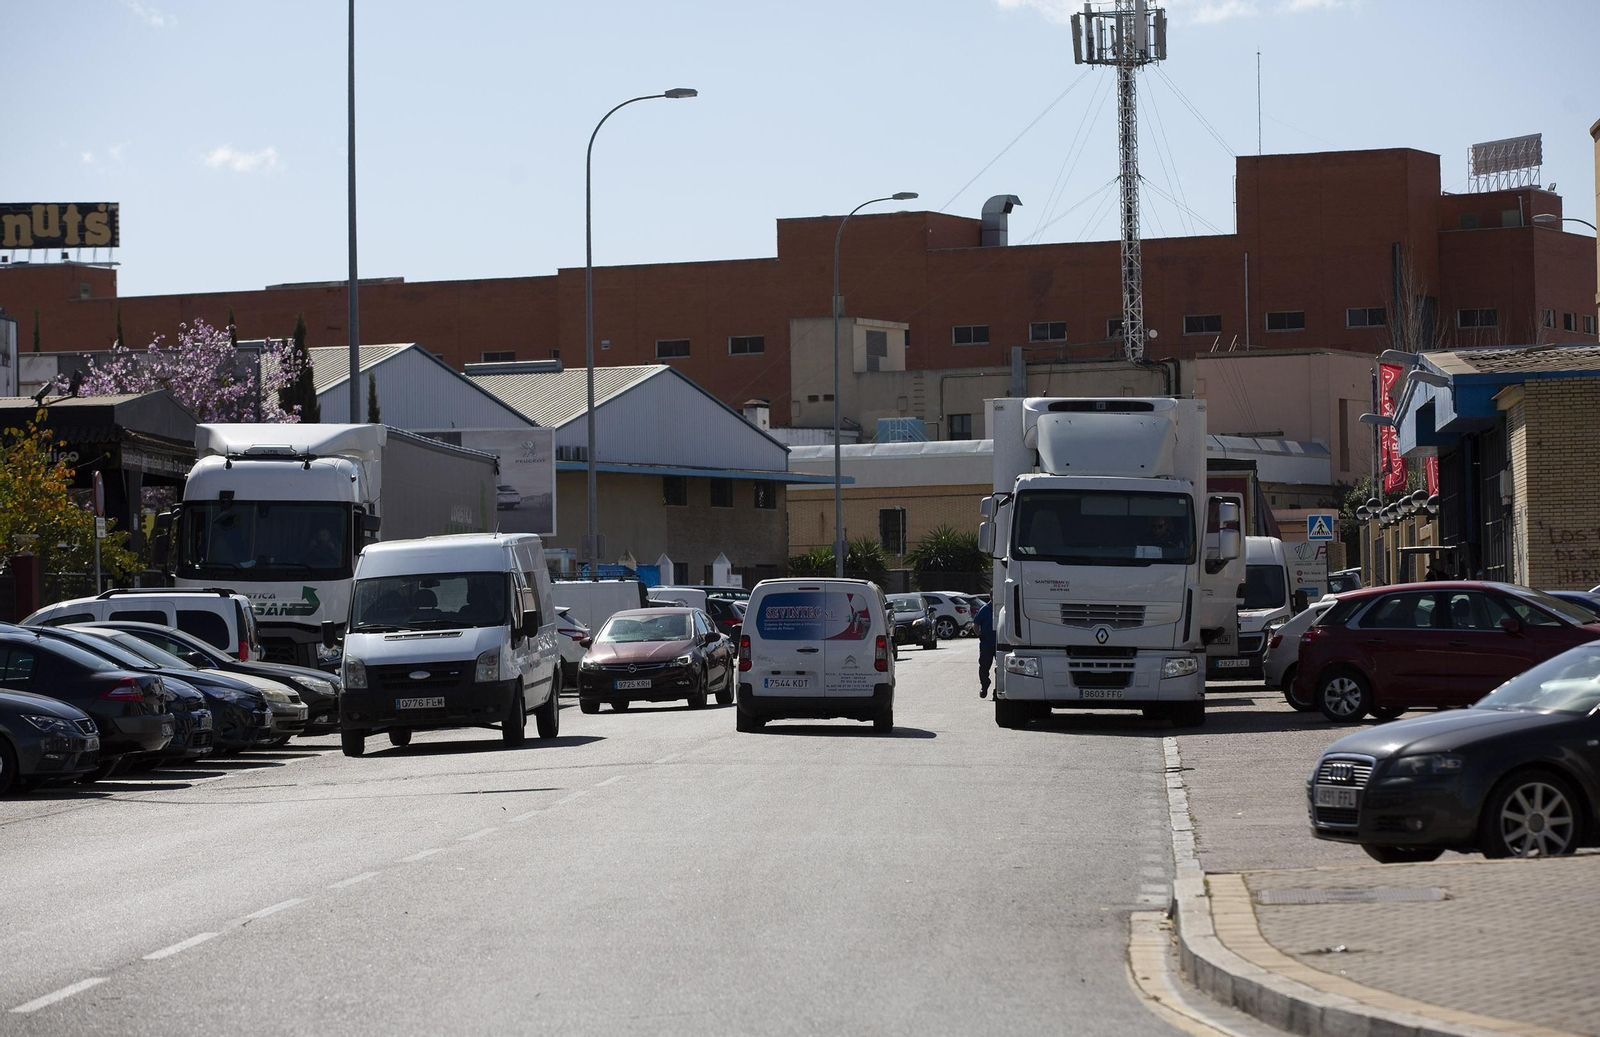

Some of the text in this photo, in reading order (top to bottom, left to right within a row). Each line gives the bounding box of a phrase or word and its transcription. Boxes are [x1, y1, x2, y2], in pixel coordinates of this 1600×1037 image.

[2, 204, 111, 246] nuts
[1549, 528, 1588, 544] LOS
[765, 606, 822, 619] SEVINTEC
[769, 679, 809, 687] 7544 KDT
[1084, 690, 1122, 698] 9603 FFG
[402, 699, 424, 708] 0776
